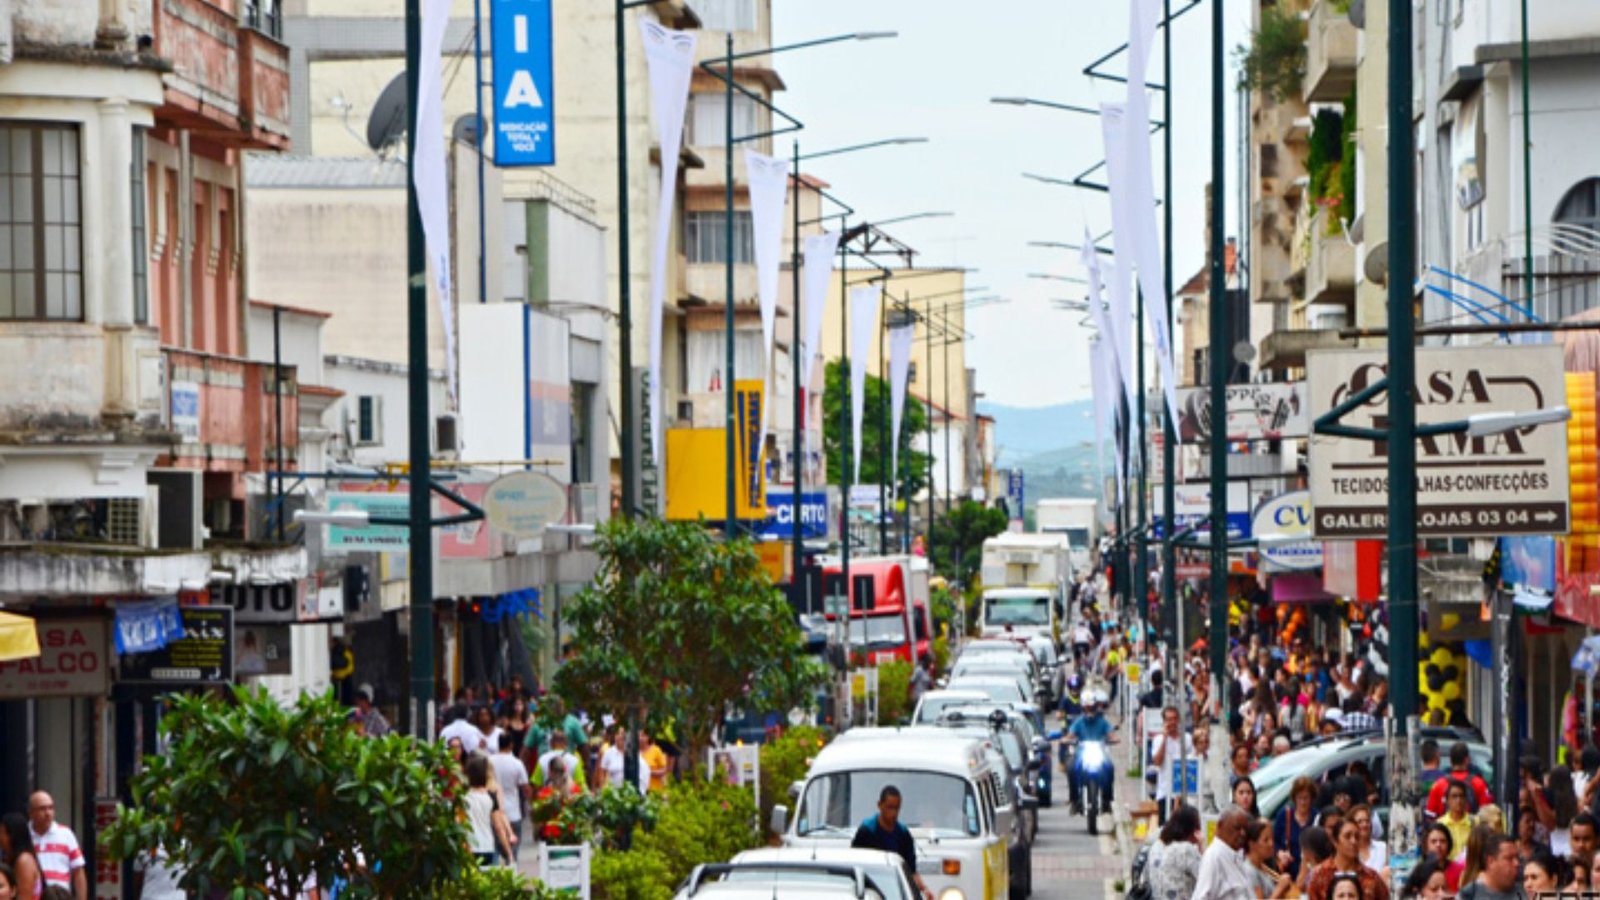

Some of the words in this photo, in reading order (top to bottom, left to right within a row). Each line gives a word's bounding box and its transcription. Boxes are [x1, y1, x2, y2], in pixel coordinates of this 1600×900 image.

[503, 0, 543, 108] IA
[1477, 510, 1500, 525] 03
[1505, 509, 1529, 524] 04
